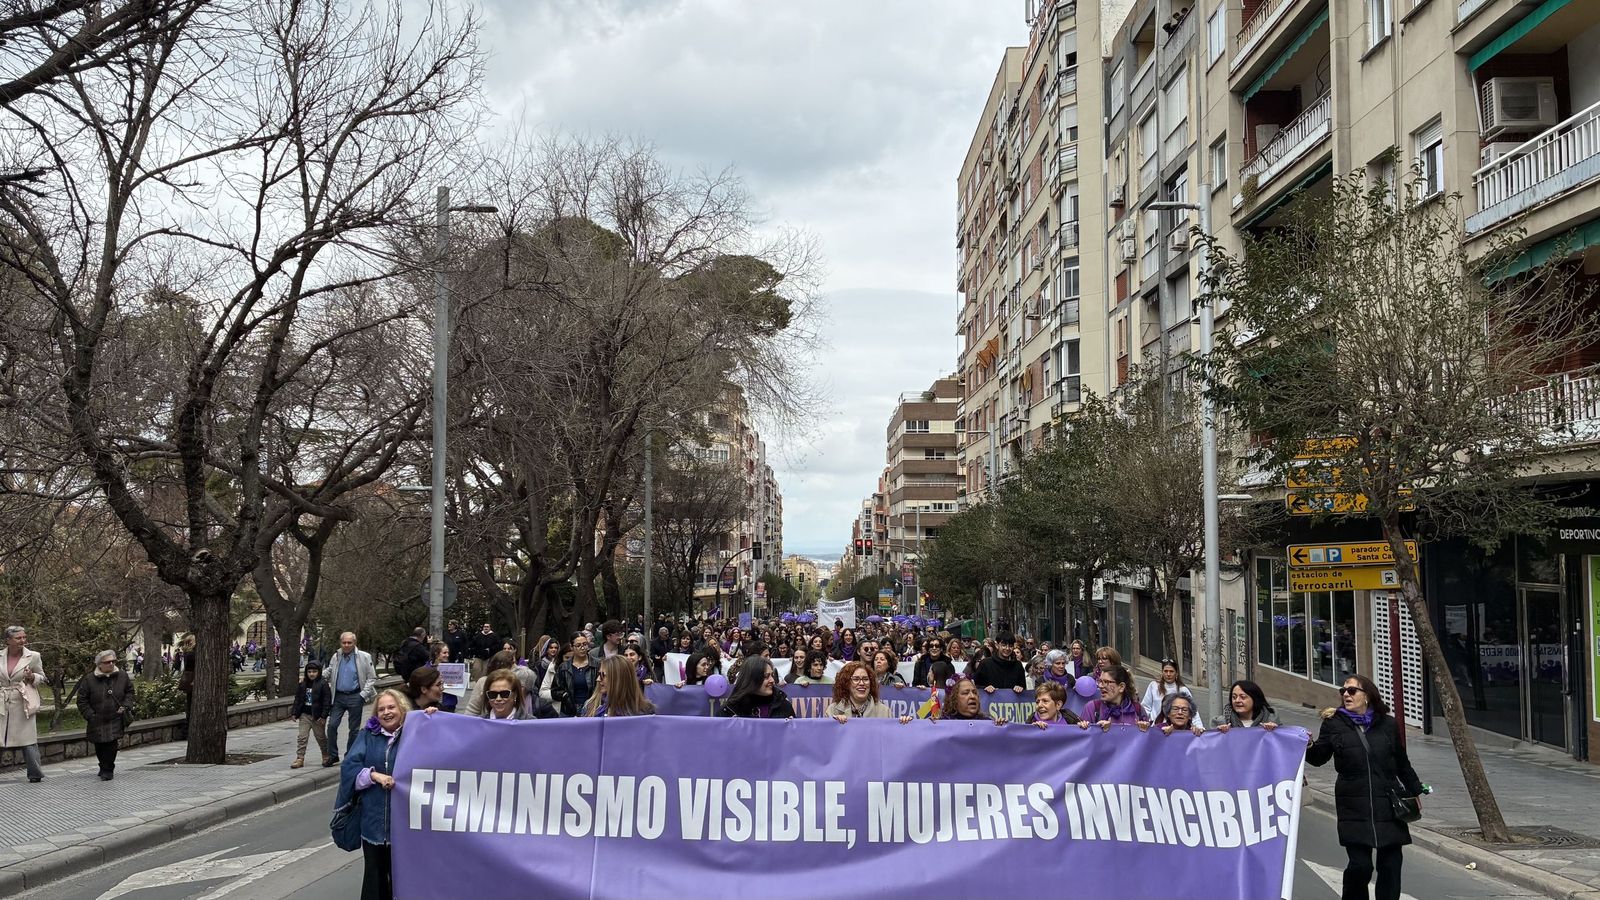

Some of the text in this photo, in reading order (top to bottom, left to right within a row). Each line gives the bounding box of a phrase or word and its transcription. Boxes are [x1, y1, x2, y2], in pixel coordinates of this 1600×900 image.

[1351, 545, 1380, 554] parador
[1357, 553, 1379, 561] Santa
[1291, 571, 1328, 579] estacion
[1293, 580, 1353, 590] ferrocarril
[989, 702, 1036, 724] SIEMP
[409, 768, 1297, 850] FEMINISMO VISIBLE, MUJERES INVENCIBLES
